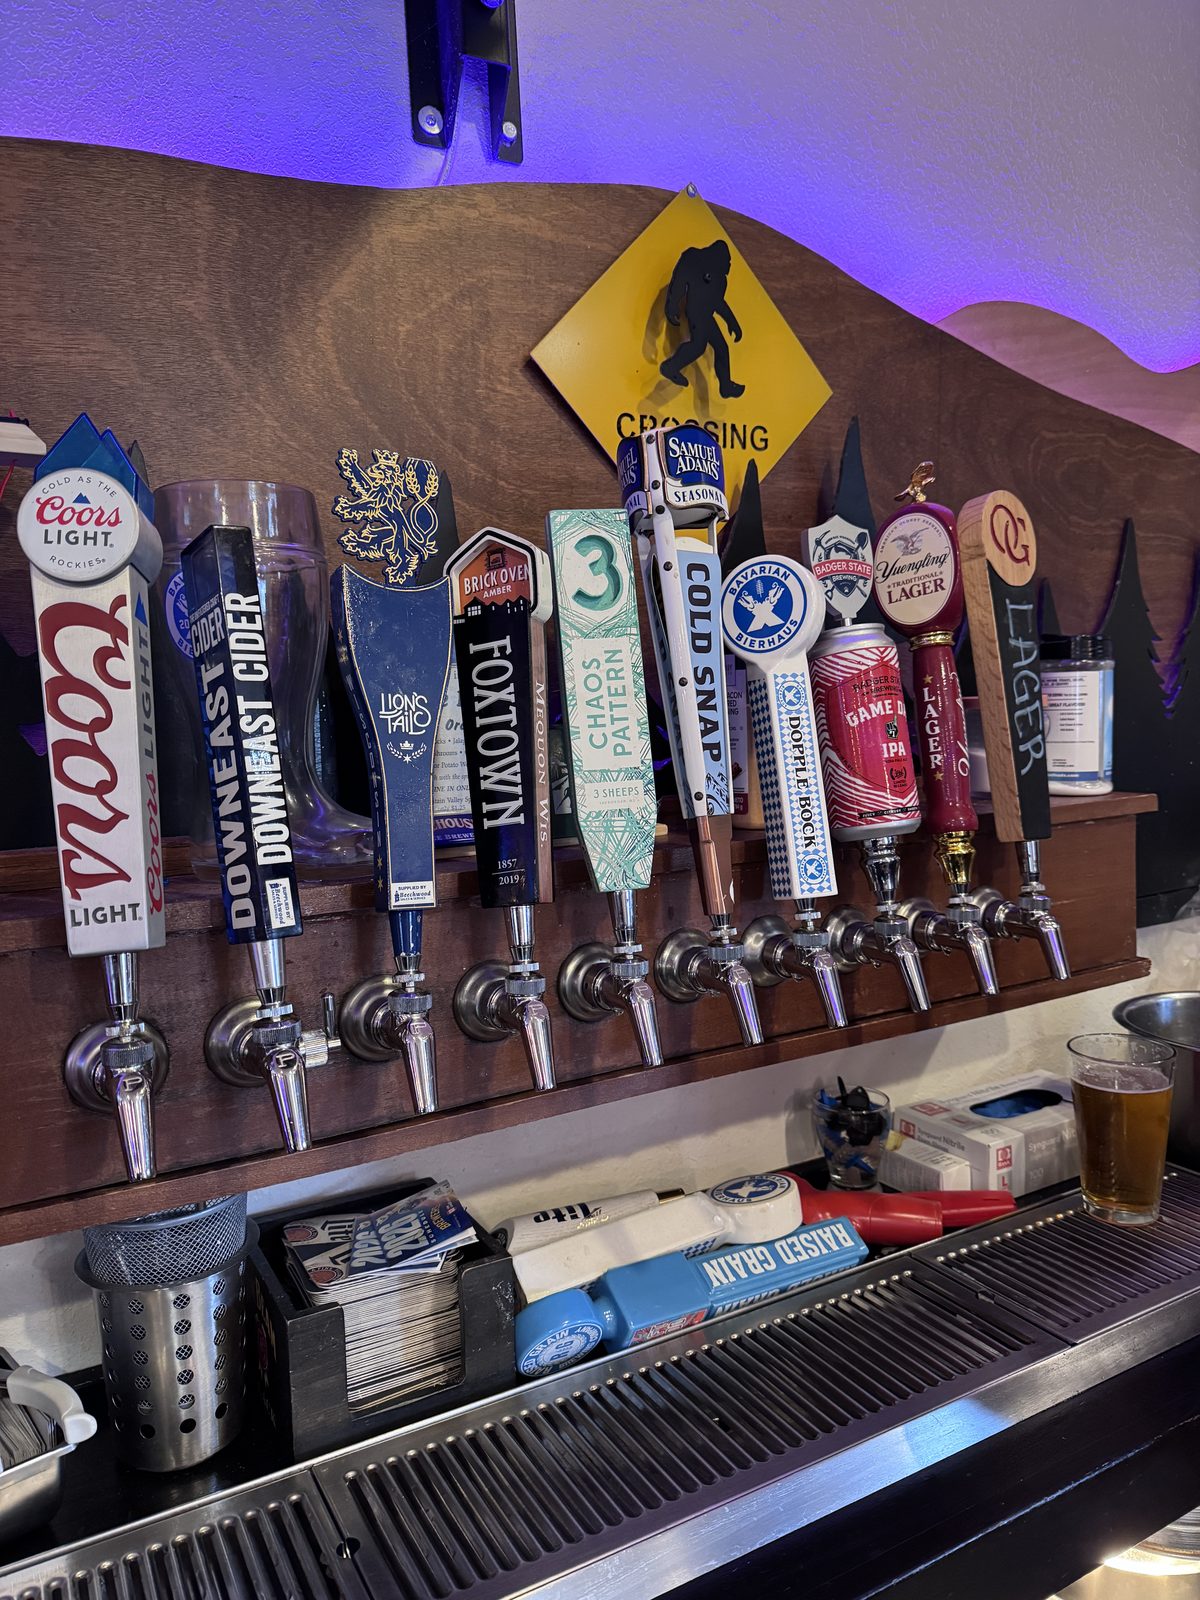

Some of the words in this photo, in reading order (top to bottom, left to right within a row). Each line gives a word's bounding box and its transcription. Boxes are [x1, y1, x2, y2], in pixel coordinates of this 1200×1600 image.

[617, 412, 769, 452] CRSING
[668, 436, 720, 466] SAMUEL
[675, 456, 719, 481] ADAMS
[42, 476, 71, 495] COLD
[77, 476, 92, 484] AS
[98, 480, 117, 498] THE
[674, 488, 724, 505] SEASONAL
[36, 495, 123, 527] Coors
[50, 555, 102, 569] ROCKIES
[463, 571, 498, 597] BRICK
[499, 563, 531, 584] OVEN
[572, 534, 624, 612] 3
[728, 565, 791, 596] BAVARIAN
[815, 561, 848, 576] BADGER
[848, 561, 872, 575] STATE
[874, 545, 951, 585] Yuengling
[892, 571, 939, 589] TRADITIONAL
[483, 584, 512, 600] AMBER
[686, 562, 712, 654] COLD
[886, 577, 946, 605] LAGER
[190, 606, 226, 658] CIDER
[224, 592, 270, 682] CIDER
[734, 618, 799, 649] BIERHAUS
[138, 630, 154, 760] LIGHT
[581, 657, 609, 750] CHAOS
[603, 648, 633, 757] PATTERN
[1005, 598, 1046, 776] LAGER
[693, 665, 723, 763] SNAP
[845, 699, 894, 727] GAME
[922, 687, 944, 770] LAGER
[38, 594, 132, 901] Coors
[468, 635, 526, 831] FOXTOWN
[535, 680, 547, 786] MEQUON
[881, 741, 907, 758] IPA
[201, 661, 258, 931] DOWNEAST
[236, 695, 294, 867] DOWNEAST
[593, 789, 600, 799] 3
[602, 786, 640, 798] SHEEPS
[788, 716, 809, 790] DOPPLE
[799, 796, 818, 849] BOCK
[145, 772, 164, 916] Coors
[497, 858, 518, 870] 1857
[498, 874, 520, 886] 2019
[69, 902, 140, 928] LIGHT
[1001, 1175, 1008, 1187] L
[776, 1221, 856, 1265] RAISED
[701, 1247, 778, 1288] GRAIN
[528, 1329, 570, 1357] GRAIN
